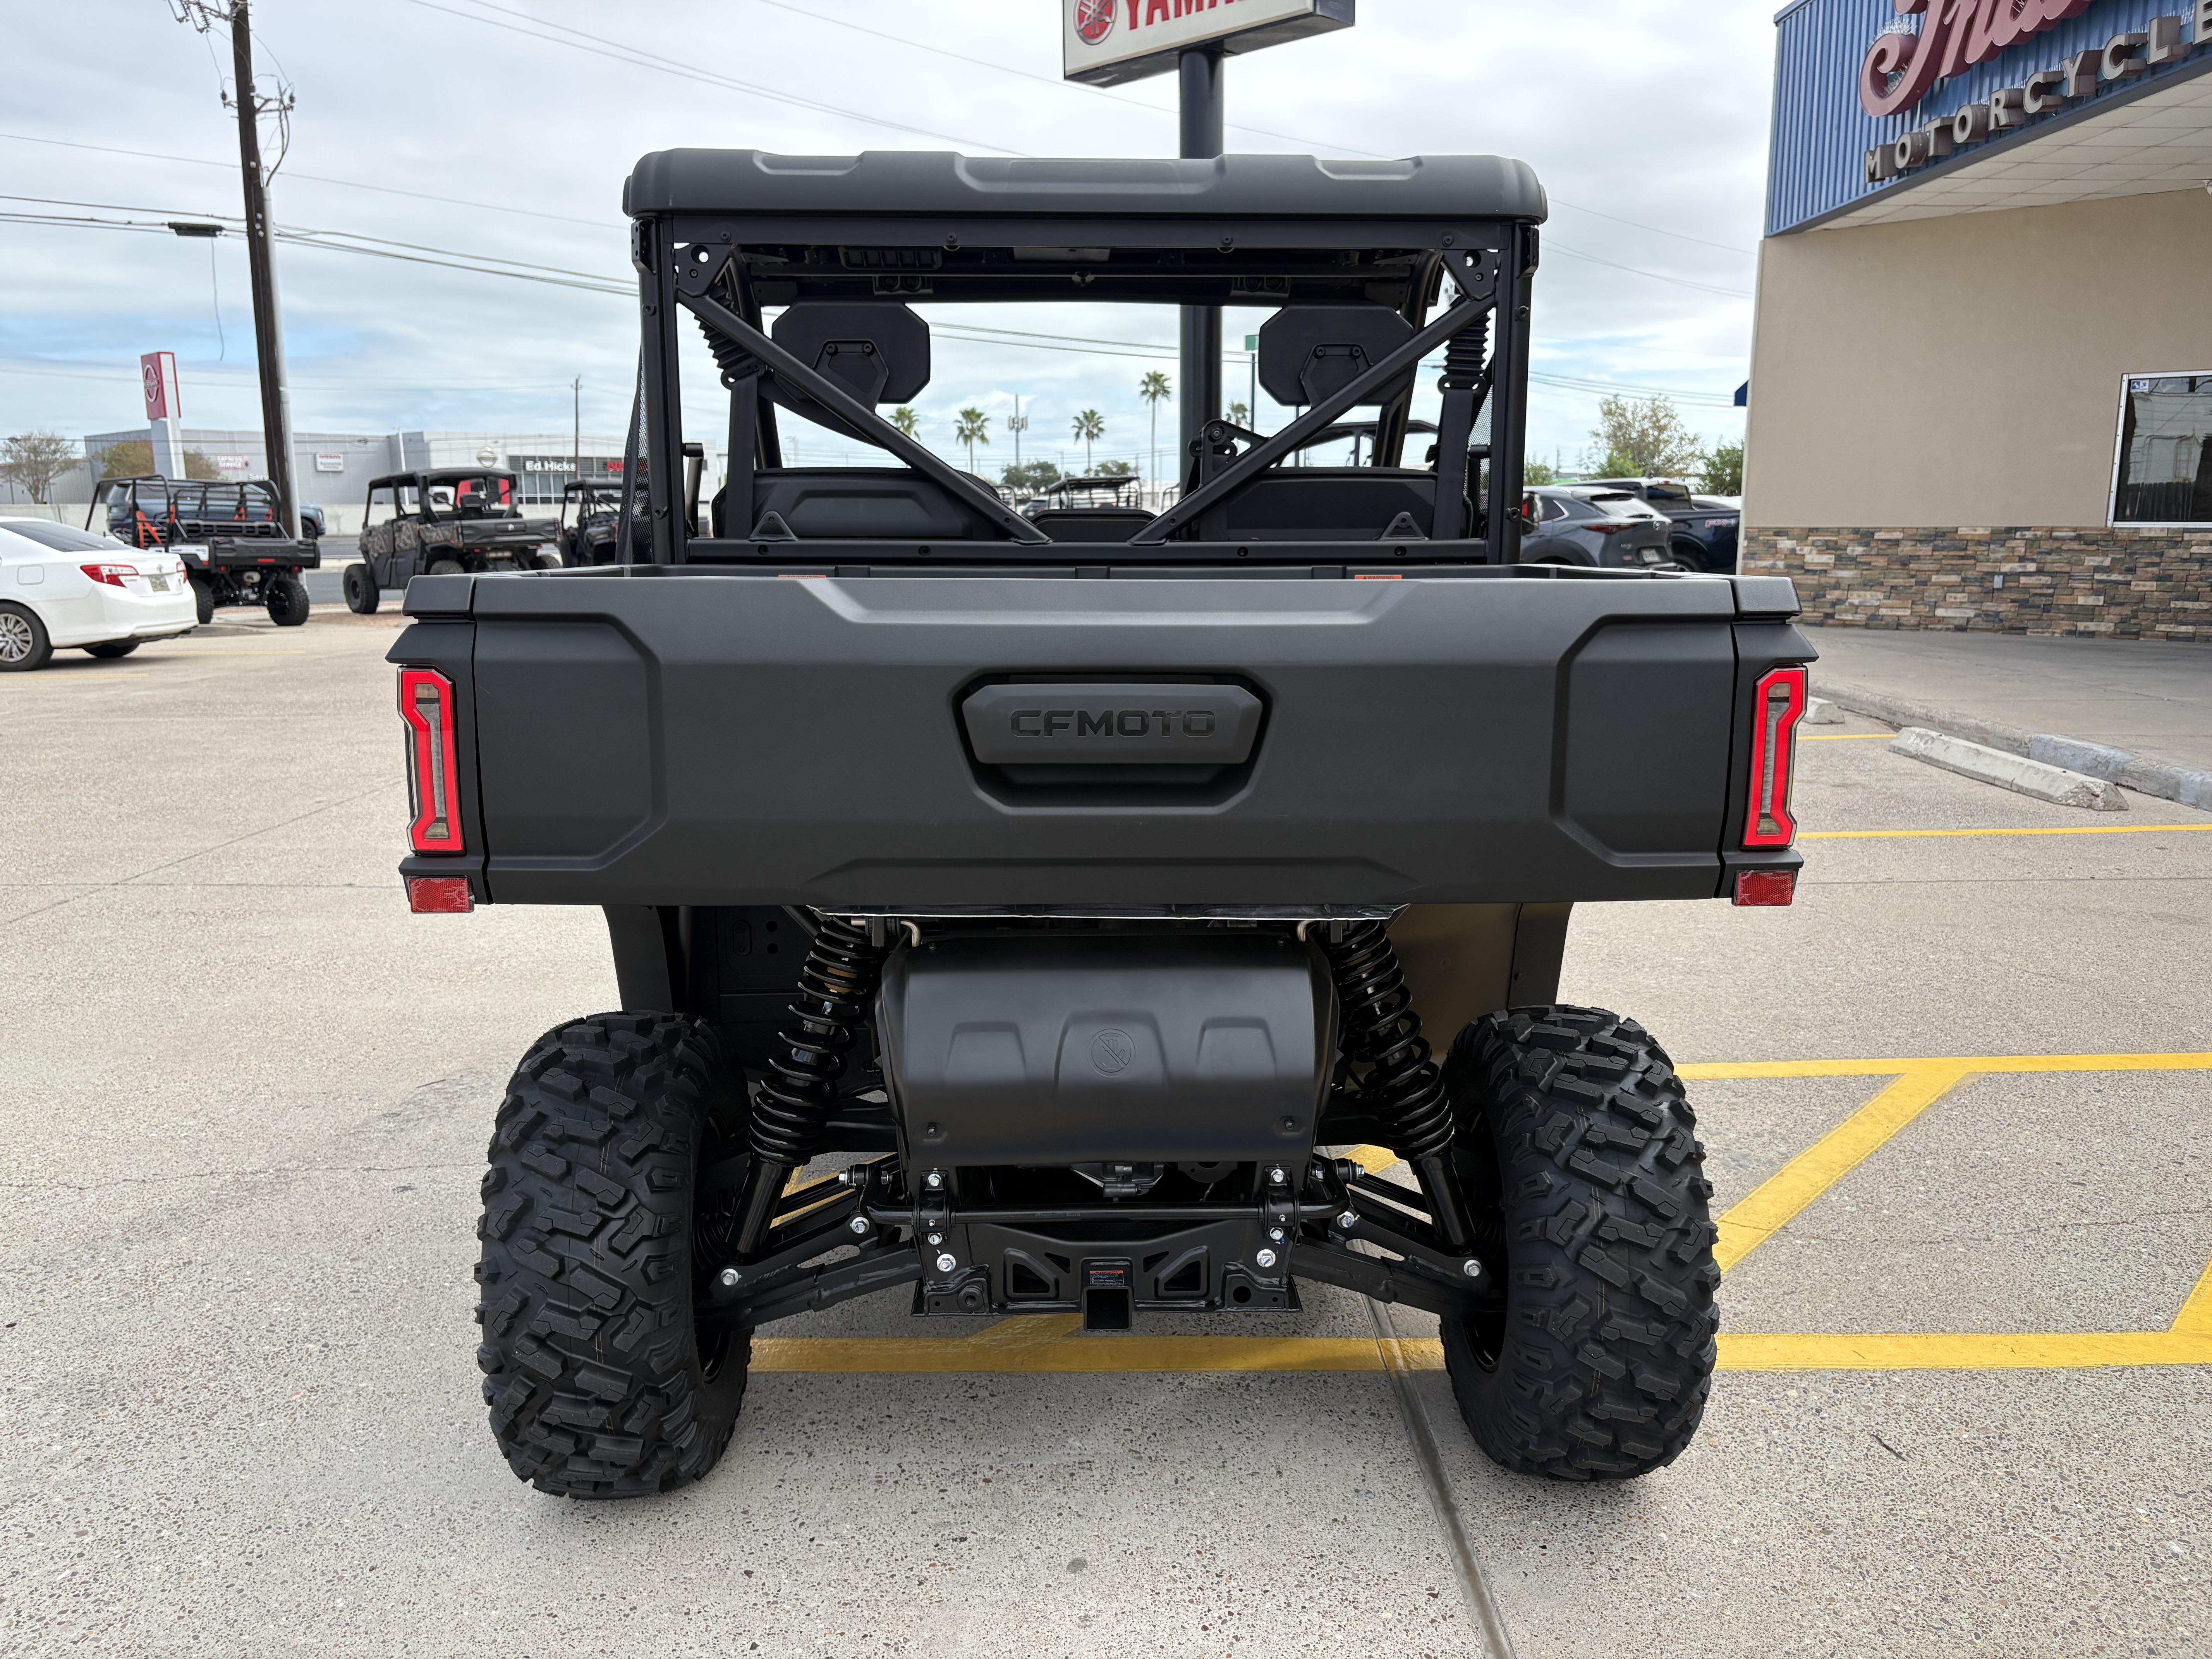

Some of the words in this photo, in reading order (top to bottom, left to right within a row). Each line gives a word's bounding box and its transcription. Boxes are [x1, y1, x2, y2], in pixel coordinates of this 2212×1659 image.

[1863, 0, 2212, 184] MOTORCYCLE
[525, 460, 542, 471] Ed
[544, 460, 576, 471] Hicks
[1011, 710, 1215, 737] CFMOTO
